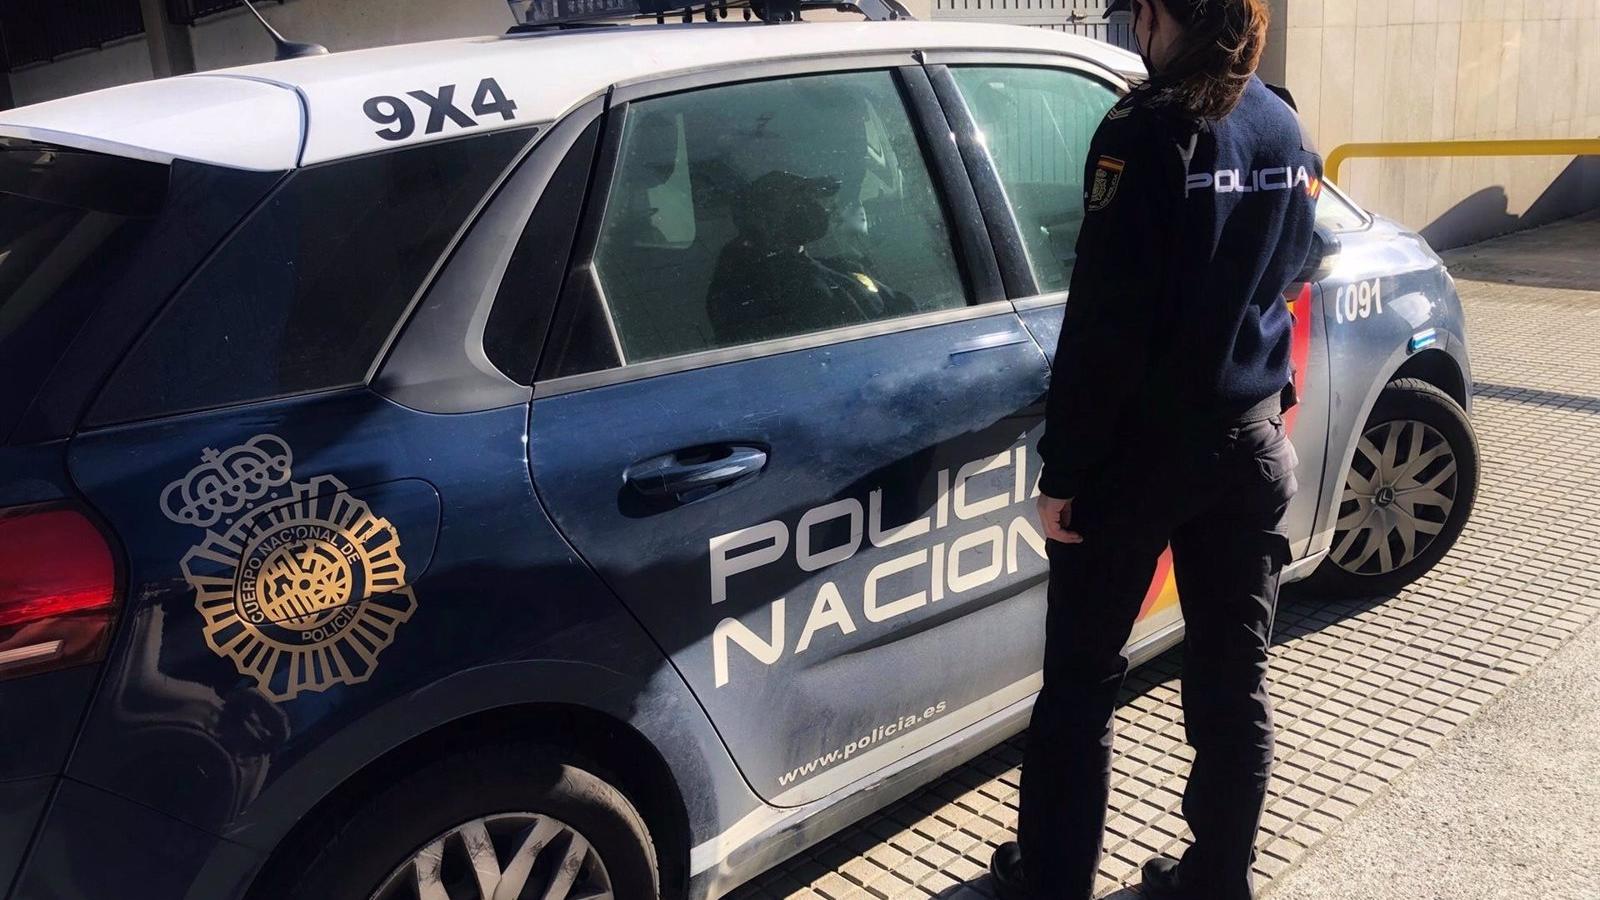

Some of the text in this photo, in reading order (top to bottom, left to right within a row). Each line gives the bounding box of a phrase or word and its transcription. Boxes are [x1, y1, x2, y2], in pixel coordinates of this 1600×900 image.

[363, 77, 517, 141] 9X4
[1185, 164, 1309, 199] POLICIA
[1344, 278, 1382, 321] 091
[242, 557, 264, 623] CUERPO
[340, 543, 361, 565] DE
[713, 516, 1048, 688] NACION
[302, 604, 358, 641] POLICIA
[778, 700, 947, 787] www.policia.es
